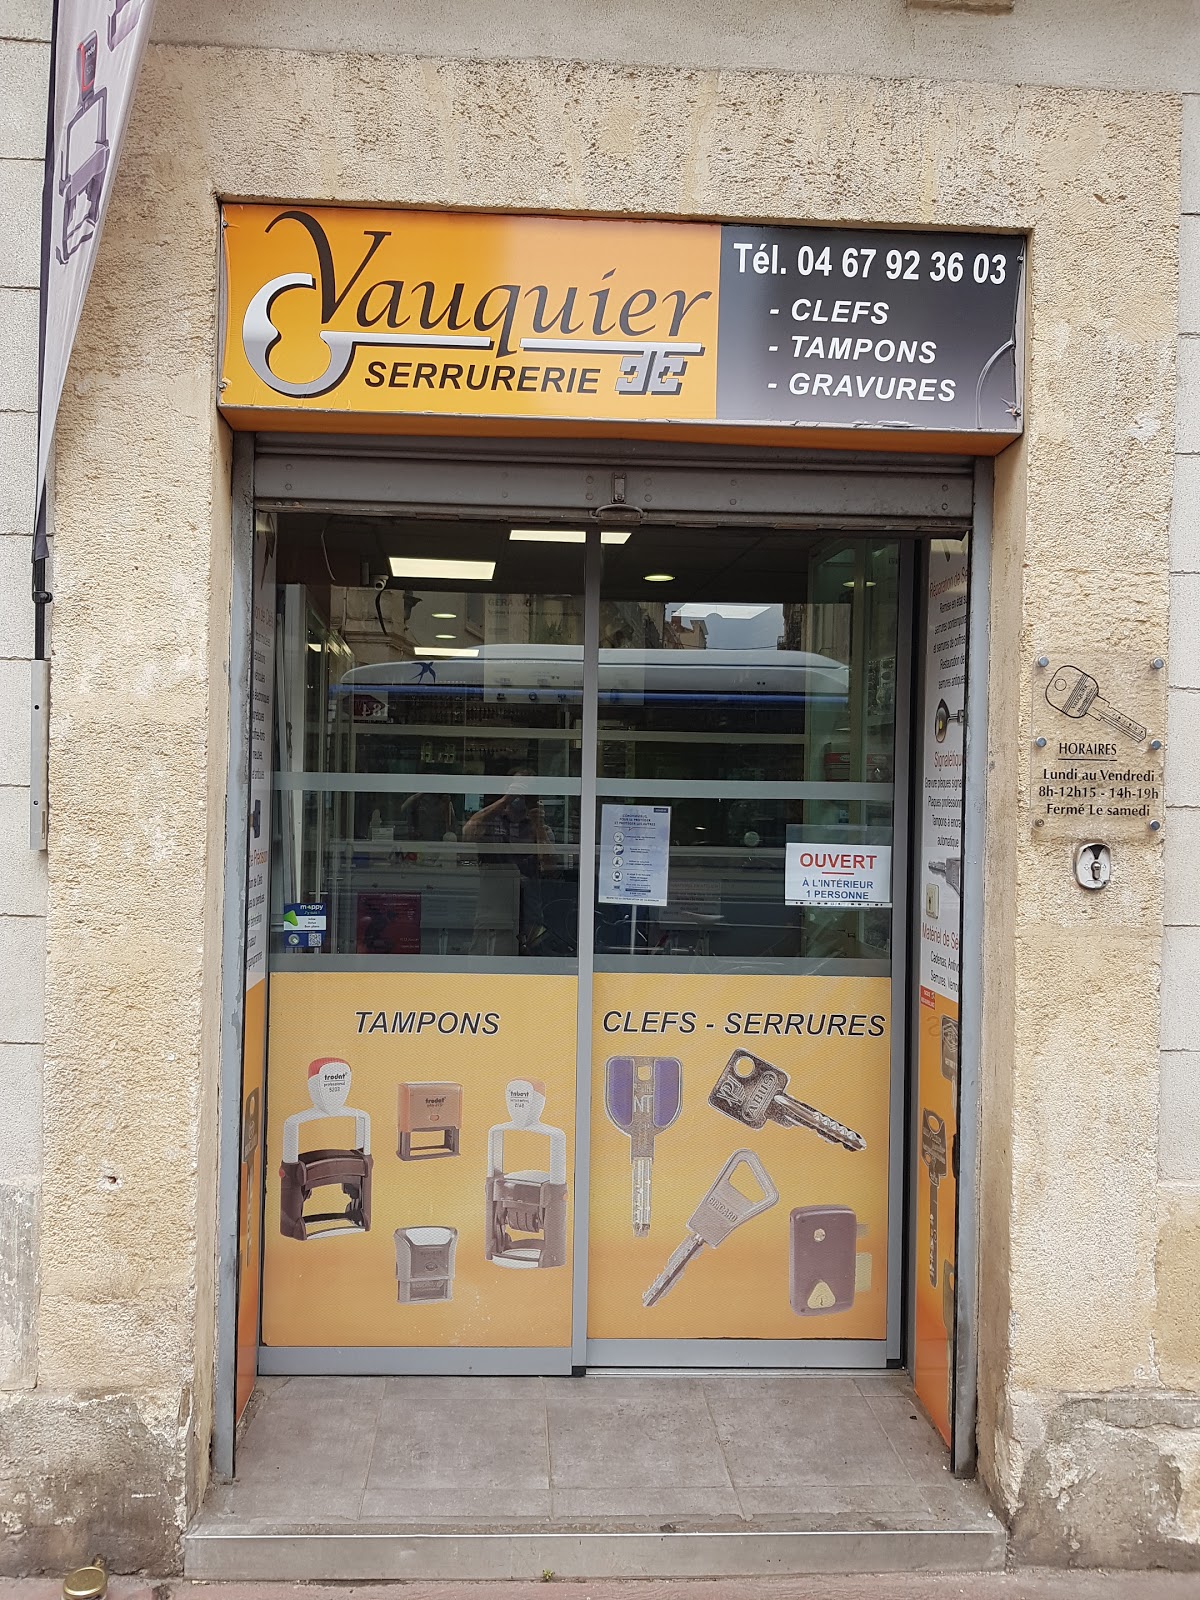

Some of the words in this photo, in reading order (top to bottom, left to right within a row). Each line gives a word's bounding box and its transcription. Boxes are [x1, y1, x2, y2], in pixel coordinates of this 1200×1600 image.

[733, 242, 787, 275] Tél.
[797, 245, 833, 277] 04
[842, 247, 877, 278] 67
[885, 249, 921, 280] 92
[929, 251, 964, 282] 36
[973, 253, 1007, 285] 03
[265, 211, 712, 357] Vauquier
[791, 298, 890, 325] CLEFS
[791, 336, 937, 364] TAMPONS
[364, 361, 601, 394] SERRURERIE
[789, 372, 957, 402] GRAVURES
[1059, 742, 1117, 756] HORAIRES
[1043, 768, 1078, 781] Lundi
[1082, 771, 1097, 781] au
[1100, 769, 1155, 782] Vendredi
[1038, 786, 1096, 798] 8h-12h15
[1109, 787, 1159, 800] 14h-19h
[1046, 803, 1085, 816] Fermé
[1089, 804, 1104, 816] Le
[1107, 805, 1150, 817] samedi
[799, 853, 877, 869] OUVERT
[802, 877, 810, 887] À
[812, 878, 874, 889] L'INTÉRIEUR
[806, 890, 811, 898] 1
[814, 890, 869, 899] PERSONNE
[354, 1010, 502, 1036] TAMPONS
[602, 1010, 697, 1035] CLEFS
[724, 1011, 886, 1037] SERRURES
[745, 1073, 775, 1119] ABUS
[708, 1196, 738, 1224] BRICARD
